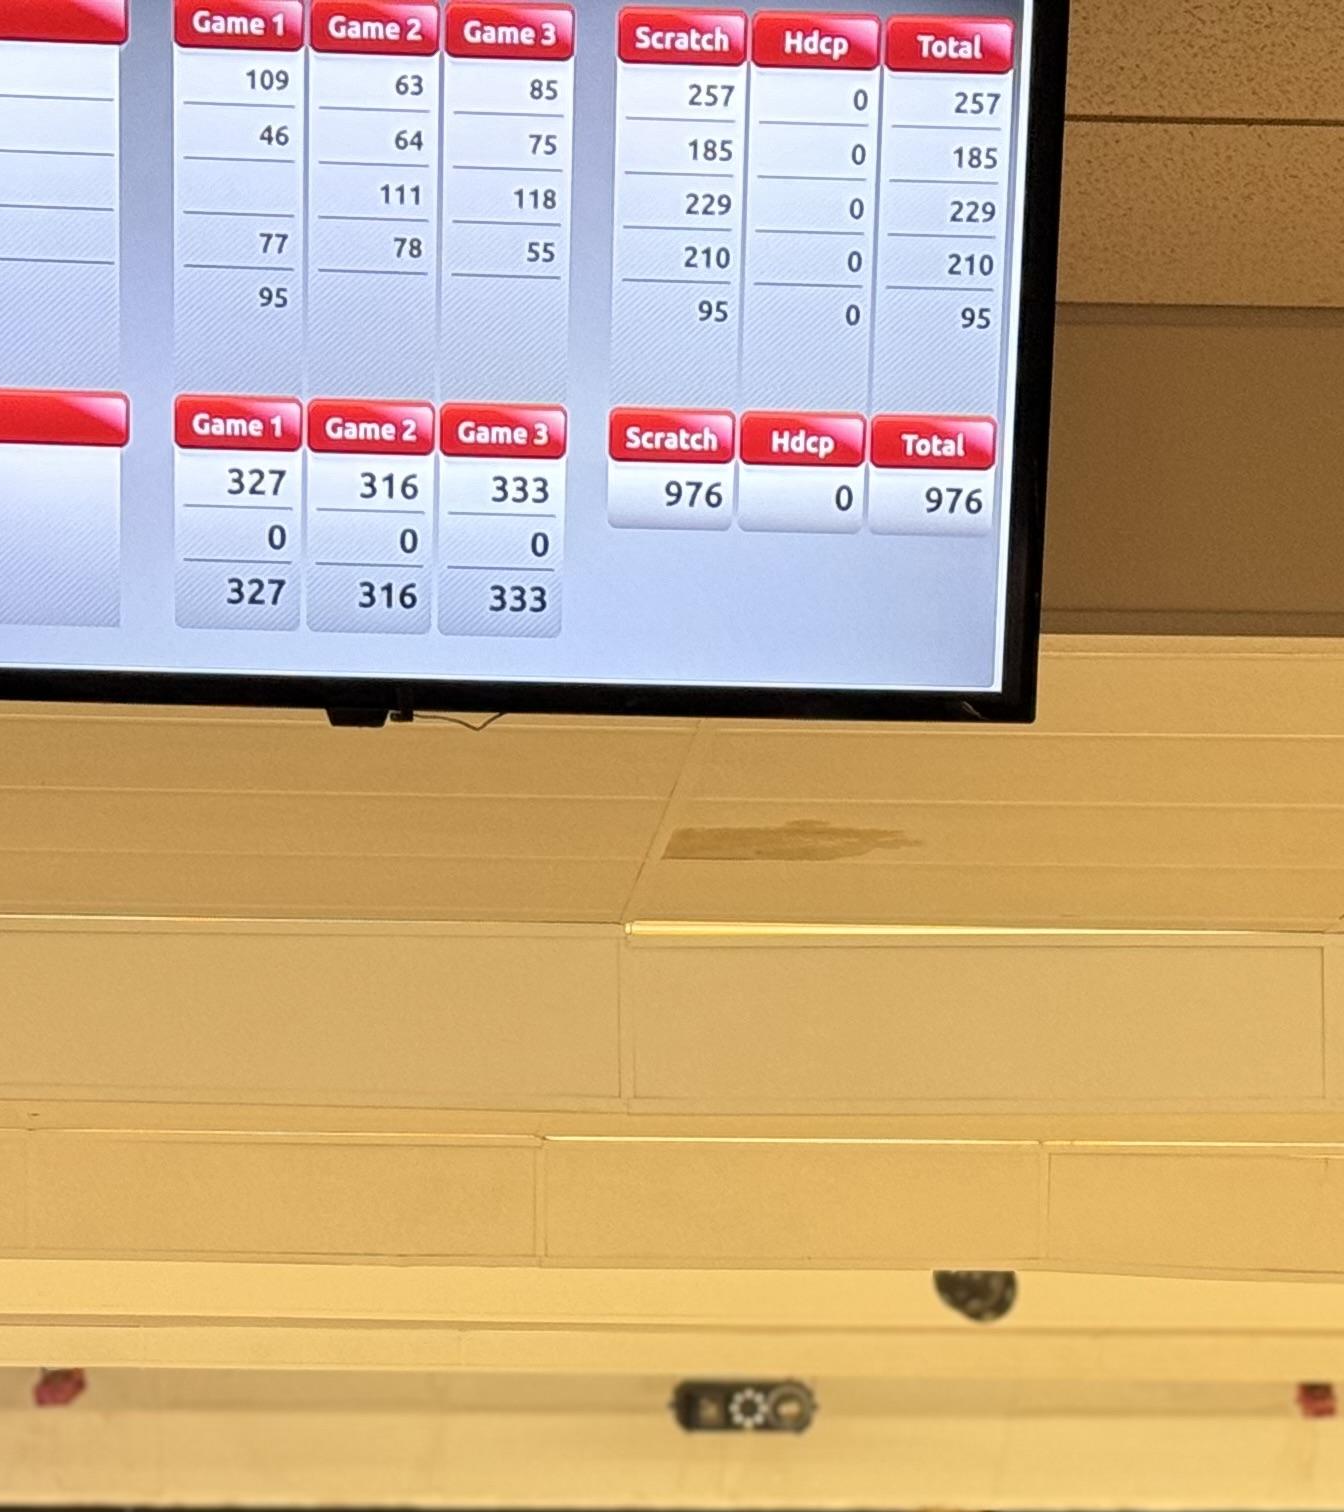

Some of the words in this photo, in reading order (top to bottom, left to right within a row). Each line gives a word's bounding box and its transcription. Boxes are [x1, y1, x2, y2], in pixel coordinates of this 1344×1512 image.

[192, 10, 265, 36] Game
[272, 14, 284, 35] 1
[328, 15, 401, 40] Game
[406, 18, 421, 40] 2
[463, 20, 536, 44] Game
[540, 23, 556, 45] 3
[635, 27, 729, 52] Scratch
[784, 30, 848, 59] Hdcp
[918, 34, 982, 59] Total
[247, 70, 289, 90] 109
[396, 75, 423, 95] 63
[530, 79, 557, 100] 85
[689, 84, 734, 106] 257
[854, 89, 868, 111] 0
[955, 92, 1000, 114] 257
[260, 126, 289, 146] 46
[395, 130, 423, 150] 64
[529, 135, 556, 155] 75
[689, 139, 732, 161] 185
[852, 144, 866, 165] 0
[954, 147, 997, 169] 185
[381, 184, 419, 205] 111
[515, 189, 556, 209] 118
[686, 193, 731, 215] 229
[850, 198, 864, 219] 0
[951, 201, 995, 222] 229
[260, 233, 288, 254] 77
[394, 238, 421, 258] 78
[527, 242, 554, 262] 55
[685, 247, 730, 269] 210
[848, 251, 862, 272] 0
[948, 254, 993, 276] 210
[259, 287, 287, 307] 95
[699, 301, 727, 322] 95
[846, 305, 860, 326] 0
[962, 308, 990, 329] 95
[192, 414, 264, 436] Game
[270, 417, 283, 437] 1
[325, 418, 395, 441] Game
[401, 420, 417, 442] 2
[457, 421, 528, 444] Game
[532, 424, 550, 445] 3
[625, 427, 718, 452] Scratch
[771, 430, 835, 458] Hdcp
[901, 434, 965, 458] Total
[228, 469, 286, 495] 327
[360, 473, 418, 499] 316
[492, 476, 548, 503] 333
[666, 481, 722, 508] 976
[836, 486, 853, 511] 0
[926, 488, 982, 514] 976
[269, 525, 286, 550] 0
[400, 529, 417, 553] 0
[532, 533, 549, 557] 0
[227, 578, 285, 605] 327
[359, 582, 417, 609] 316
[490, 585, 546, 612] 333
